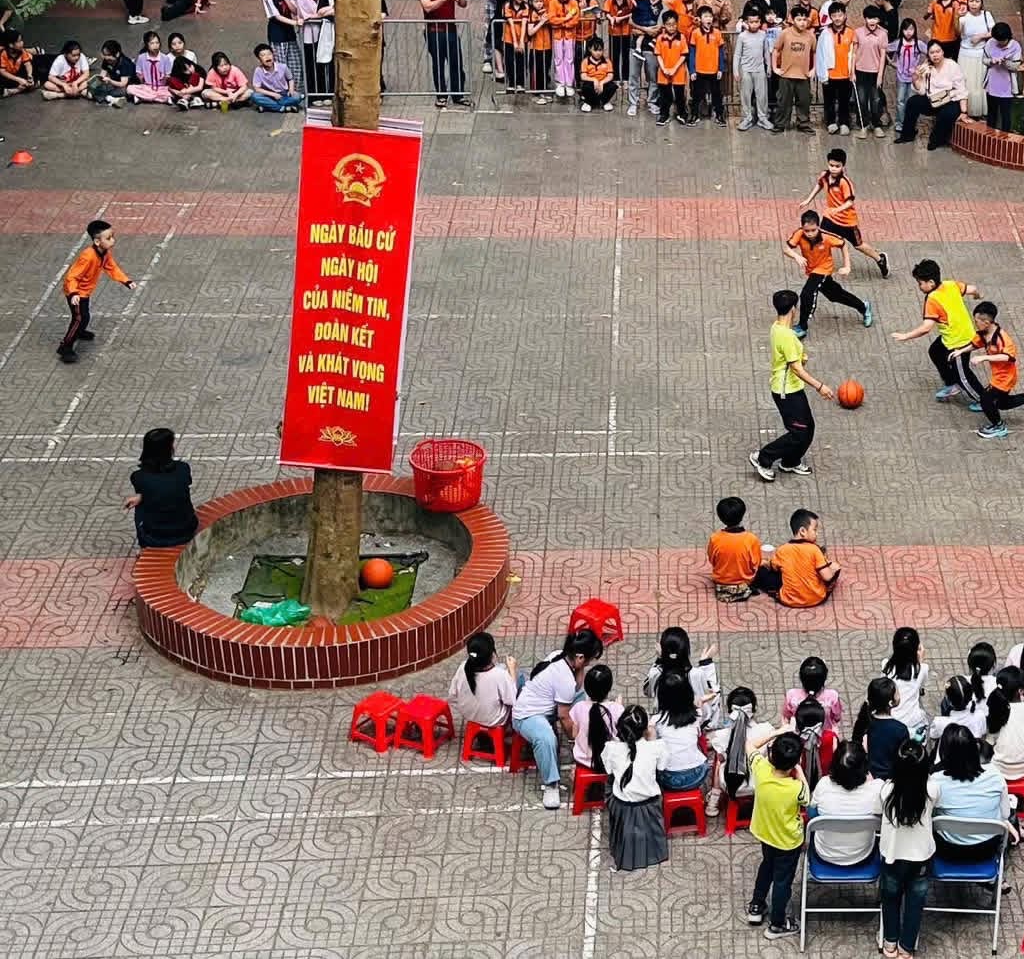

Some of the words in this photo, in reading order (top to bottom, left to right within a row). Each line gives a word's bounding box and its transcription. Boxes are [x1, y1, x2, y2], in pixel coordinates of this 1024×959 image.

[310, 221, 345, 244] NGÀY
[348, 223, 373, 248] BẦU
[377, 226, 396, 252] CỬ
[320, 254, 354, 278] NGÀY
[356, 260, 379, 286] HỘI
[303, 285, 328, 311] CỦA
[366, 297, 391, 320] TIN,
[314, 319, 349, 344] ĐOÀN
[351, 324, 375, 348] KẾT
[298, 351, 315, 374] VÀ
[317, 353, 349, 377] KHÁT
[351, 359, 385, 383] VỌNG
[307, 384, 335, 408] VIỆT
[337, 390, 370, 412] NAM!
